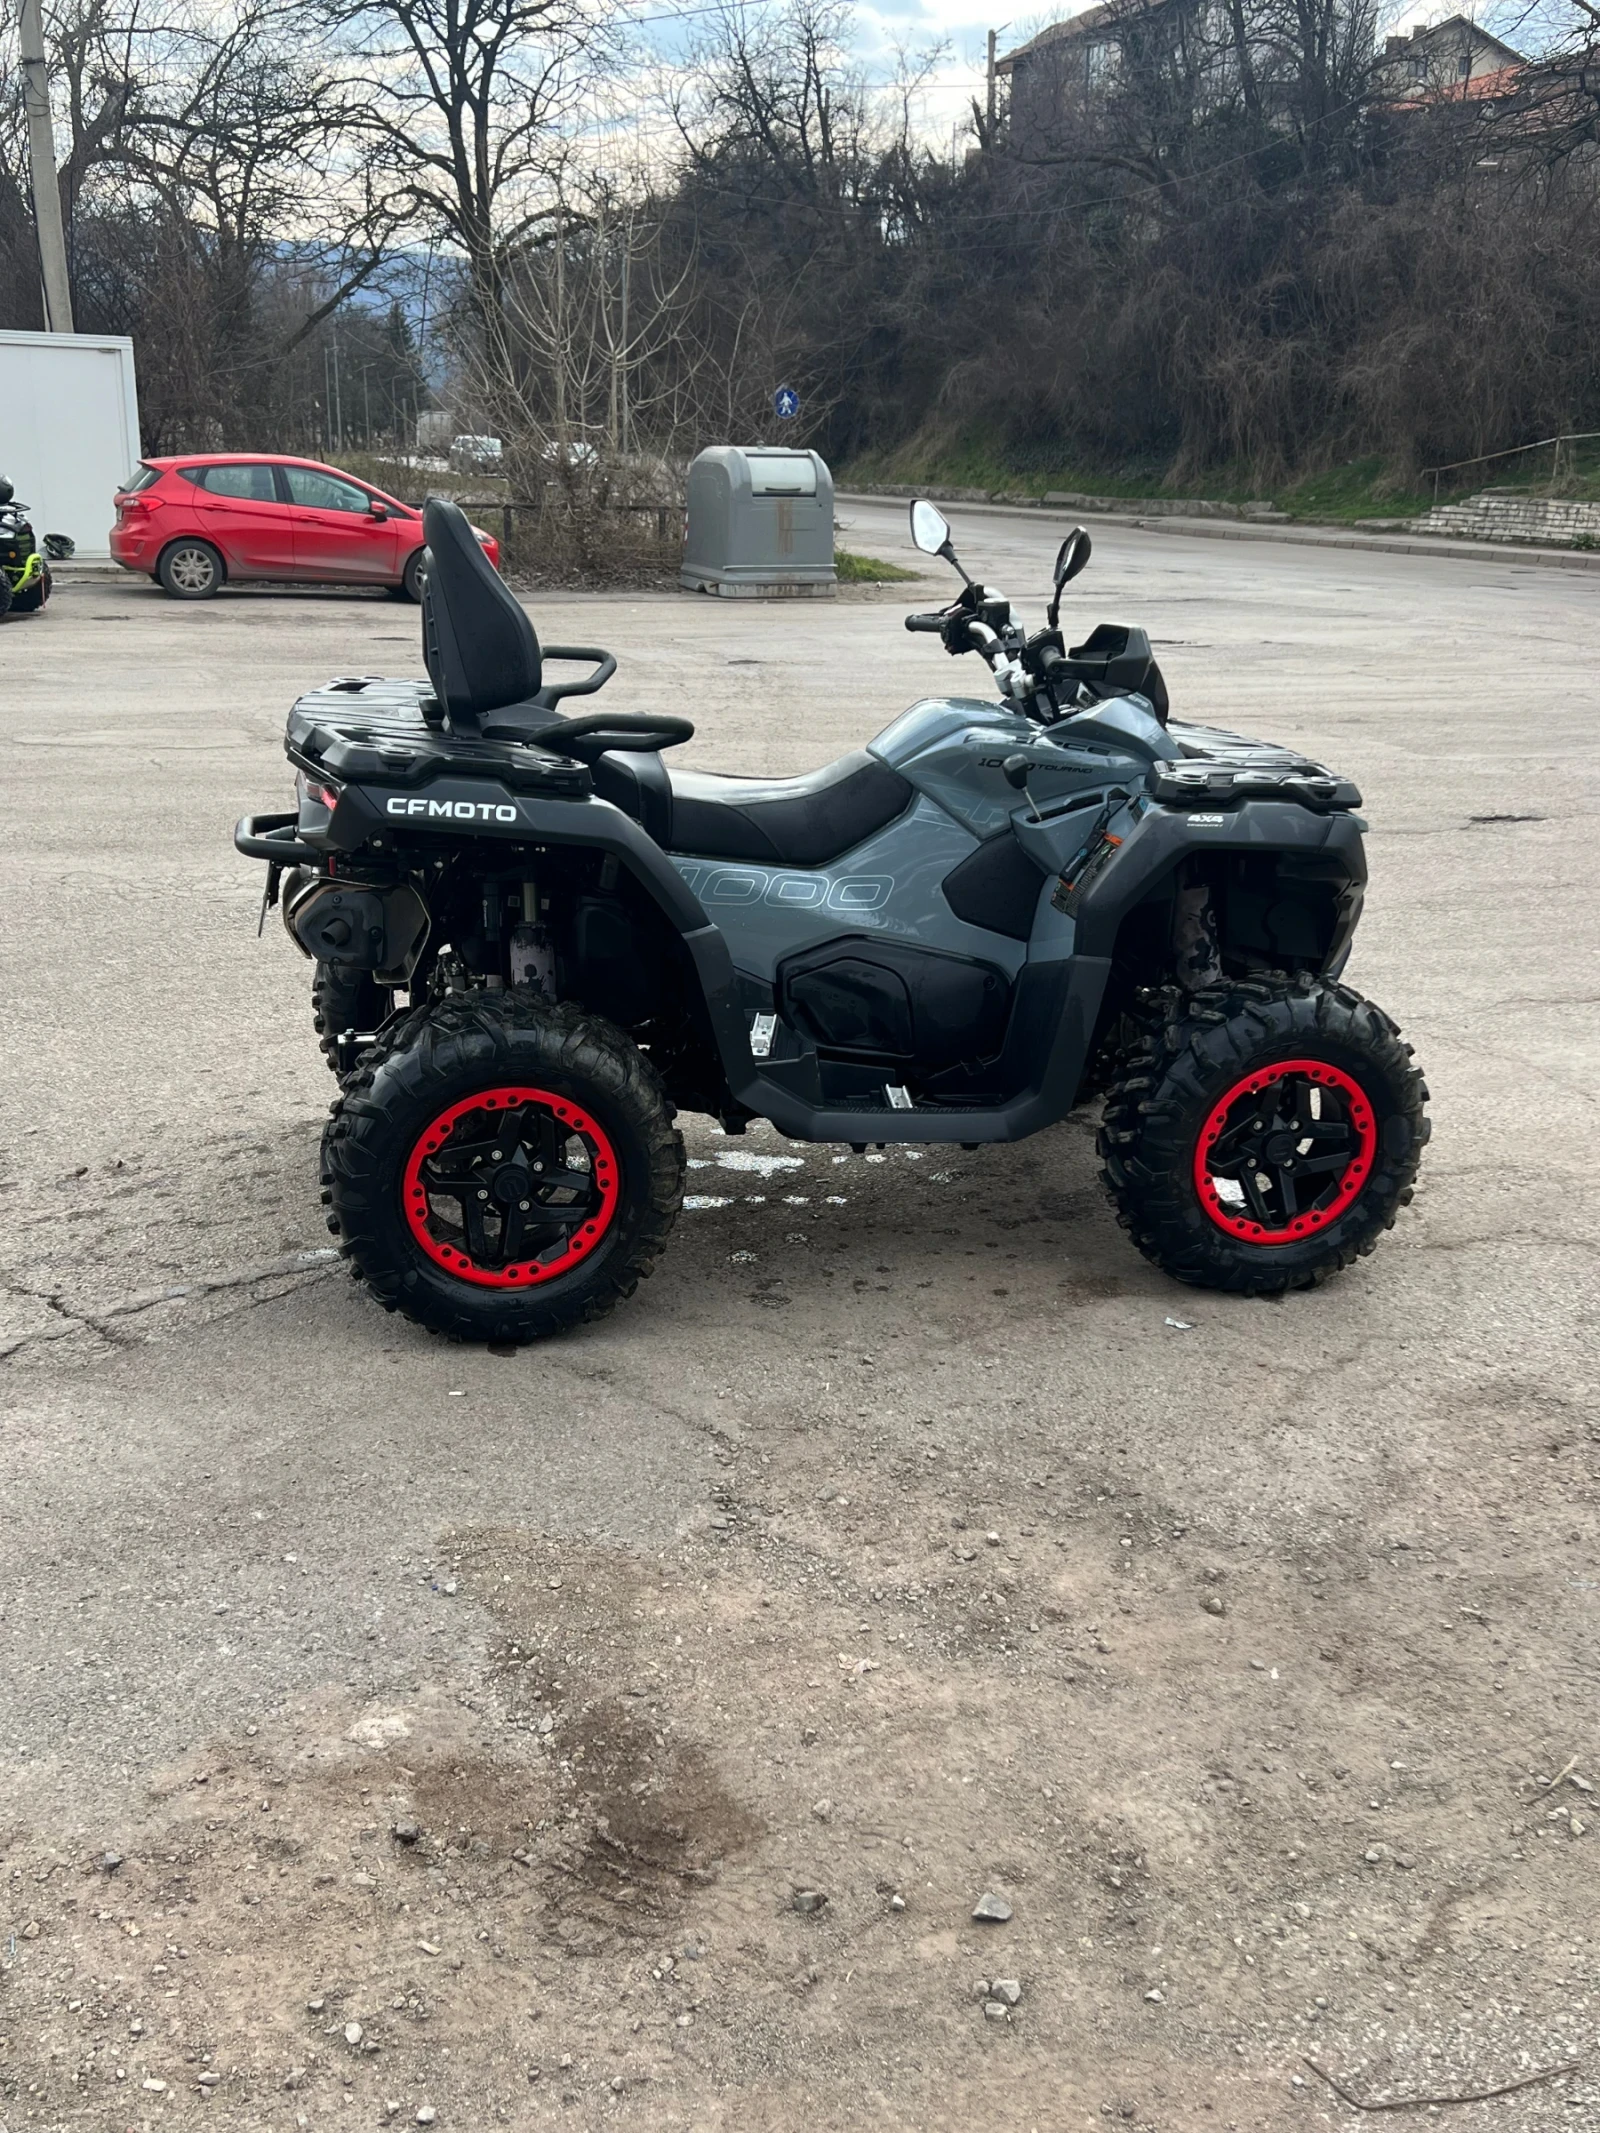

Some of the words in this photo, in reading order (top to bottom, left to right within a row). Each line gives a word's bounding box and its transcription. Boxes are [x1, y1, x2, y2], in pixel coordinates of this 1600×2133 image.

[978, 758, 1035, 771] 100
[1038, 763, 1094, 774] TOURING
[386, 797, 517, 822] CFMOTO
